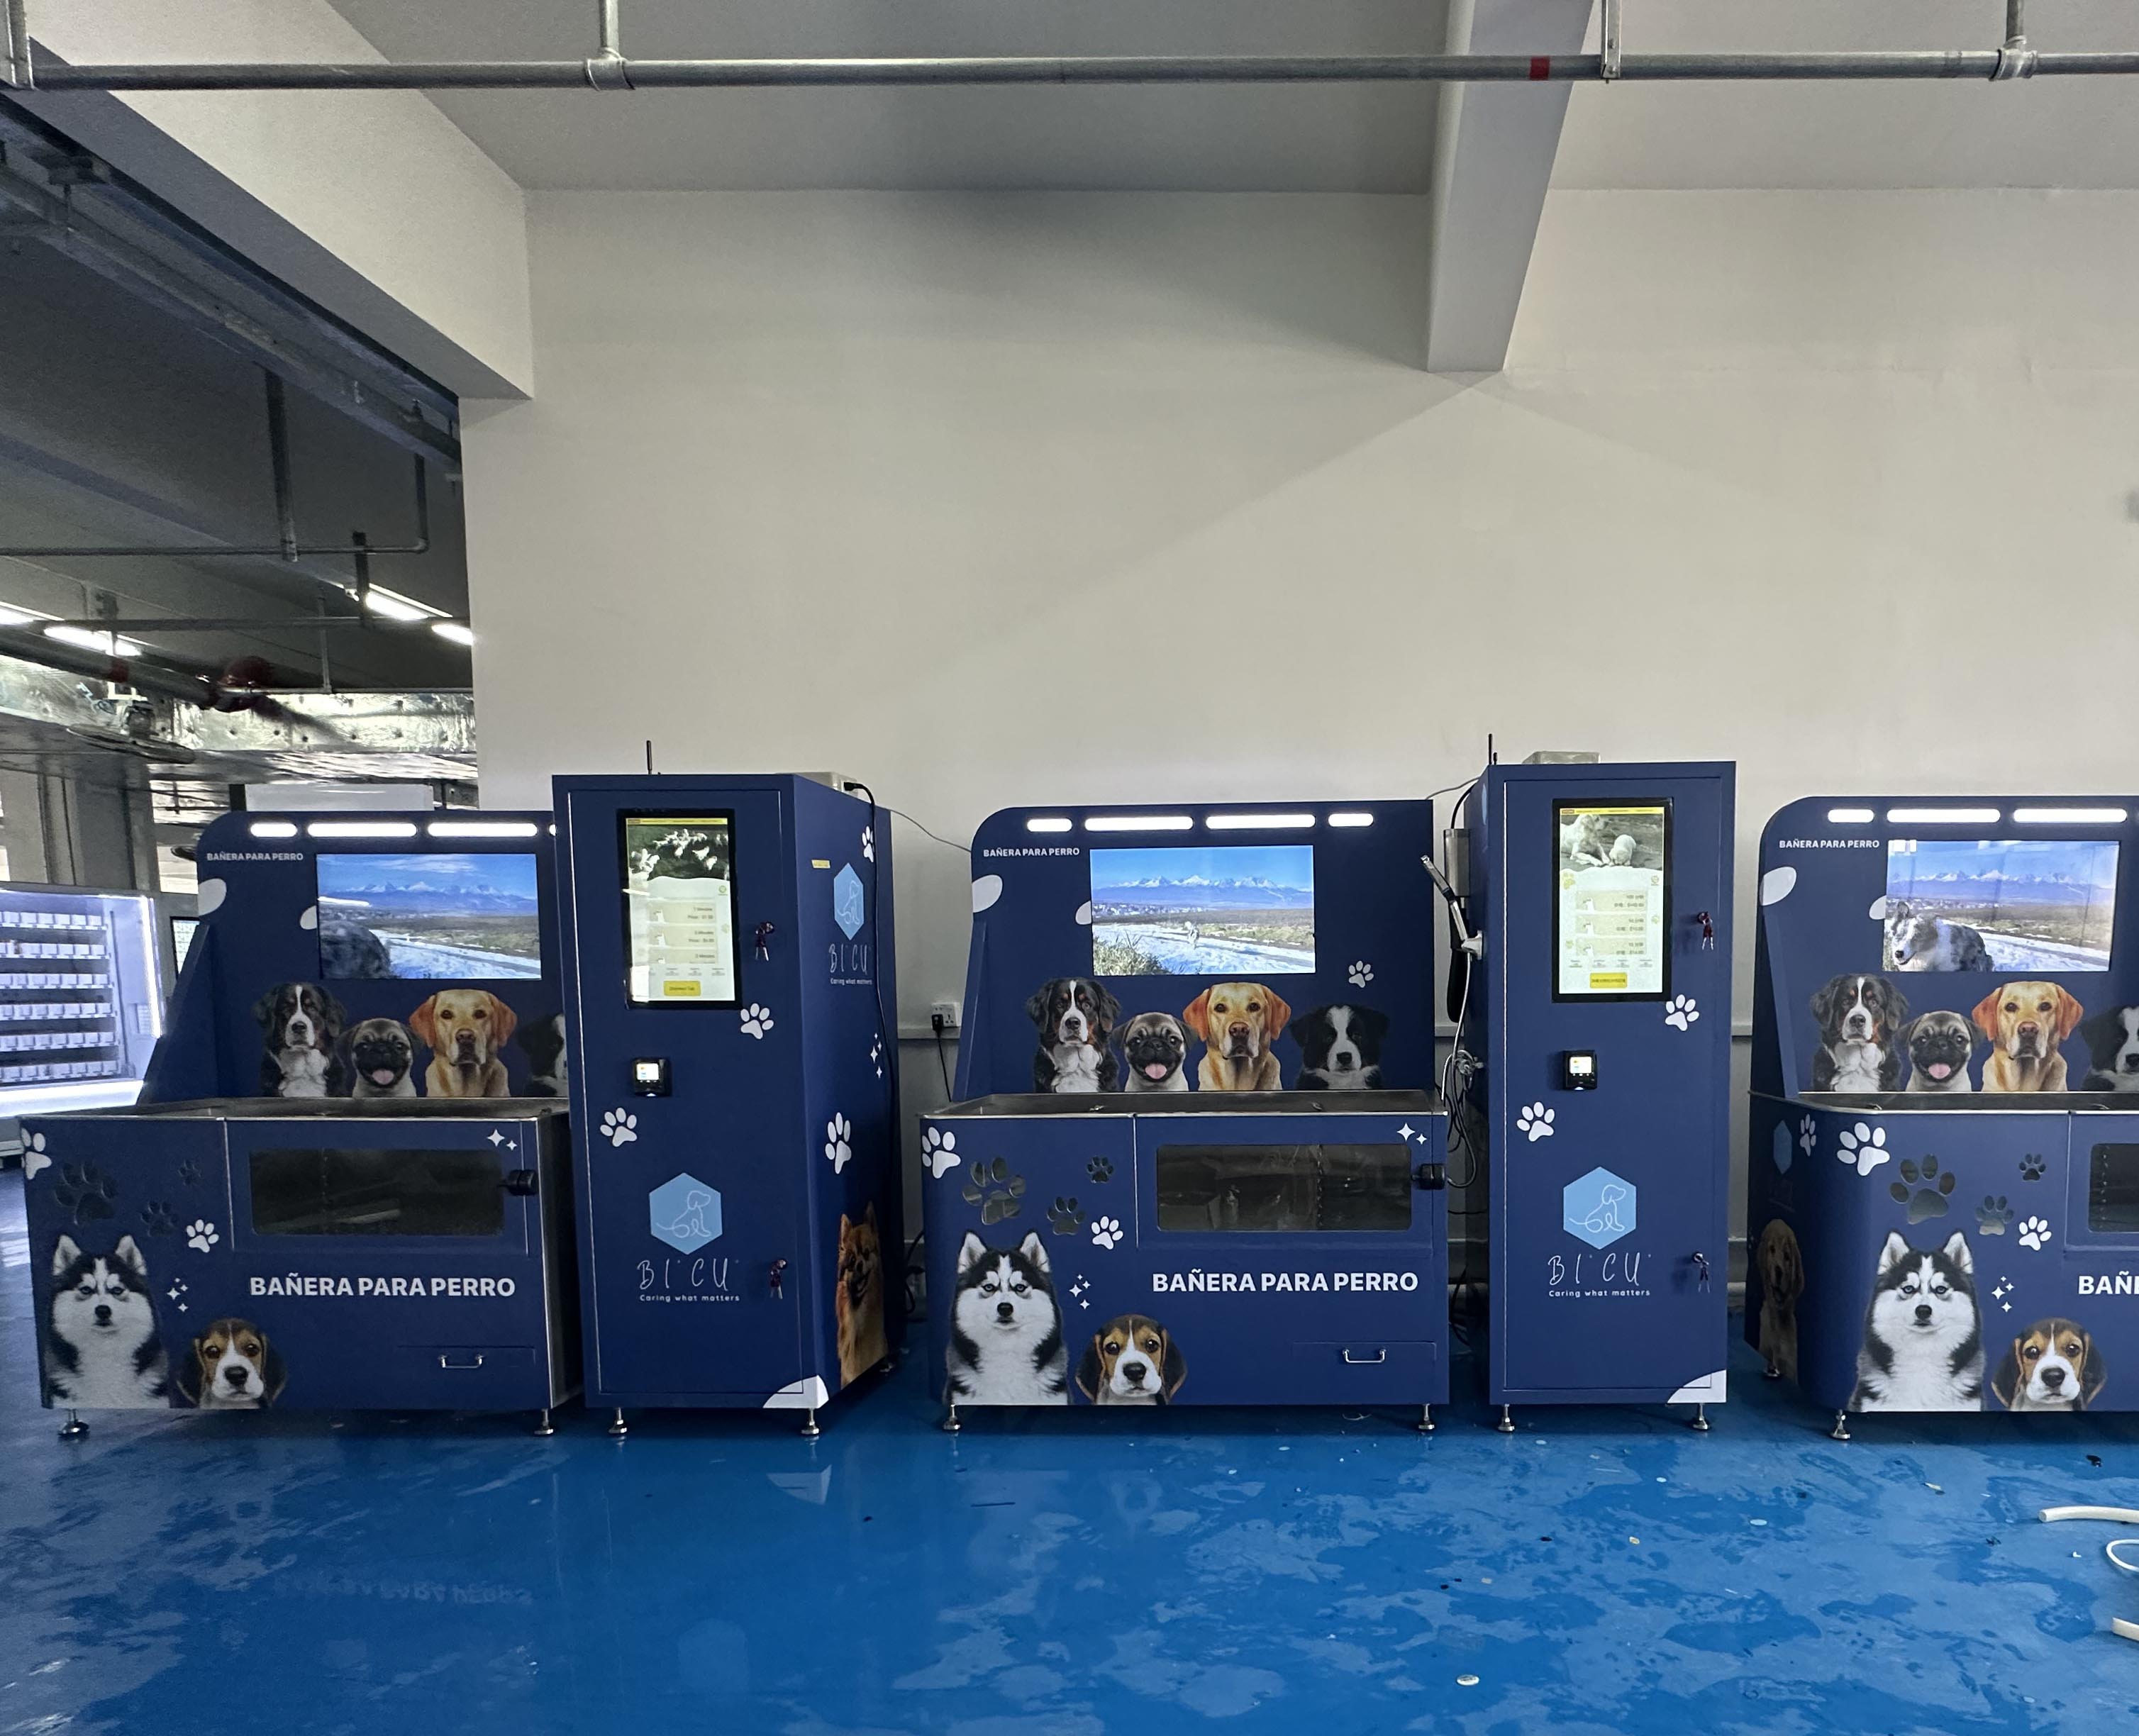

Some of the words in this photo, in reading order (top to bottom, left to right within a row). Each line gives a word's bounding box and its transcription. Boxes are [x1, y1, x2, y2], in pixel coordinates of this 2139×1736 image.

[1779, 838, 1819, 849] BAÑERA
[1820, 840, 1846, 848] PARA
[1848, 840, 1880, 848] PERRO
[206, 851, 245, 861] BAÑERA
[983, 847, 1021, 857] BAÑERA
[1022, 848, 1048, 857] PARA
[1048, 847, 1080, 856] PERRO
[250, 1272, 354, 1296] BAÑERA
[357, 1277, 427, 1296] PARA
[430, 1277, 516, 1297] PERRO
[1152, 1268, 1256, 1292] BAÑERA
[1261, 1272, 1329, 1292] PARA
[1334, 1272, 1418, 1292] PERRO
[639, 1293, 671, 1303] Caring
[1548, 1289, 1581, 1298] Caring
